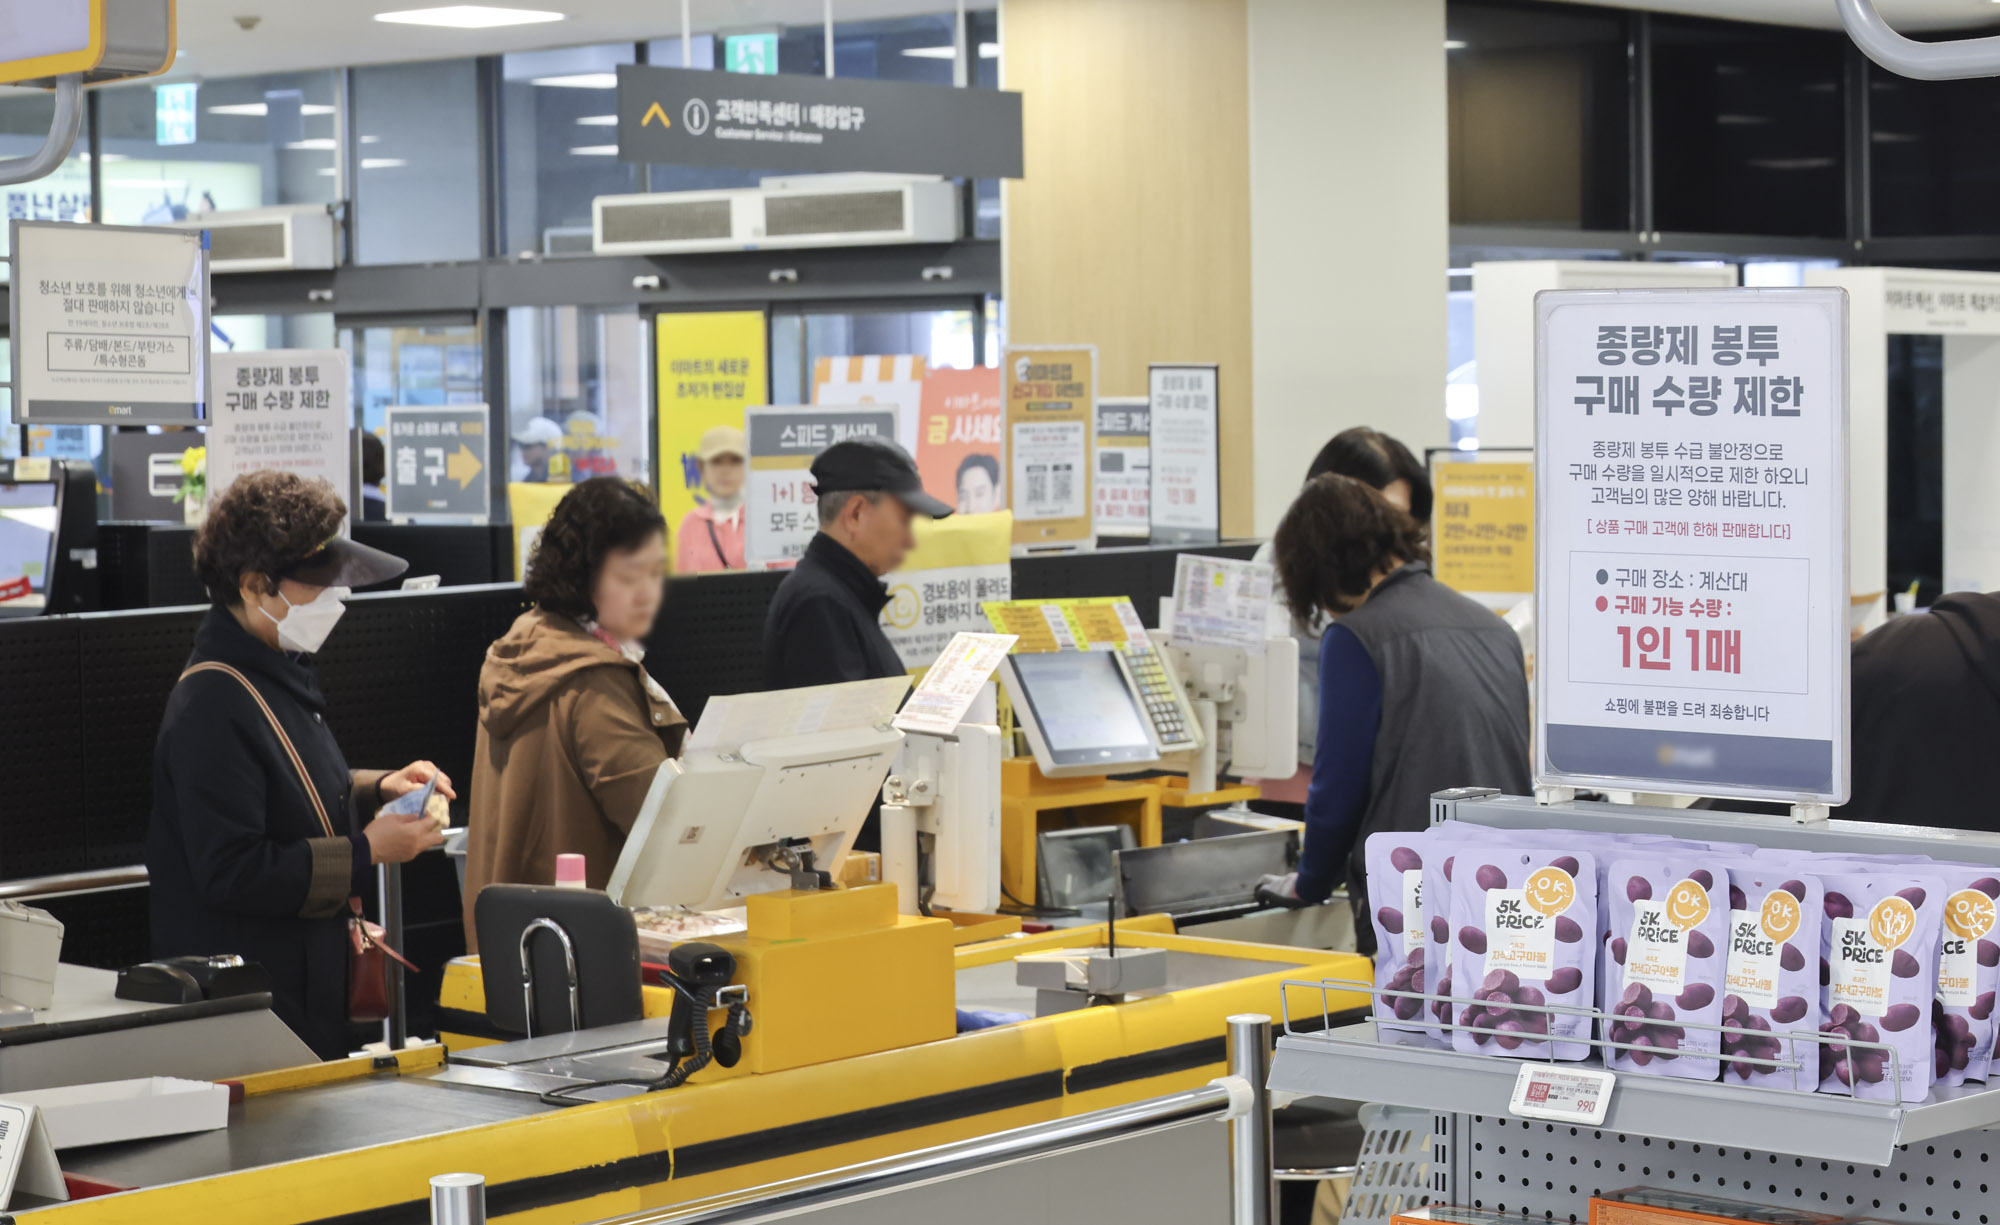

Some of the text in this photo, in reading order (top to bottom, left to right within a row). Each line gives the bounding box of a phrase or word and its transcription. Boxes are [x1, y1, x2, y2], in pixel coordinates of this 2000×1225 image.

[40, 280, 71, 295] 청소년
[75, 282, 106, 296] 보호를
[110, 283, 130, 297] 위해
[63, 298, 174, 315] 절대 판매하지 않습니다
[1596, 326, 1779, 366] 종량제 봉투
[236, 366, 319, 387] 종량제 봉투
[226, 389, 330, 412] 구매 수량 제한
[1574, 376, 1804, 417] 구매 수량 제한
[109, 406, 132, 415] emart
[781, 424, 826, 448] 스피드
[1593, 441, 1782, 461] 종량제 봉투 수급 불안정으로
[1569, 464, 1808, 486] 구매 수량을 일시적으로 제한 하오니
[772, 482, 794, 504] 1+1
[1592, 487, 1786, 508] 고객님의 많은 양해 바랍니다.
[771, 512, 797, 532] 모두
[1596, 520, 1619, 535] 상품
[1624, 521, 1648, 536] 구매
[1652, 521, 1689, 537] 고객에
[1694, 522, 1717, 537] 한해
[1722, 523, 1790, 540] 판매합니다]
[923, 579, 971, 602] 경보음이
[1615, 569, 1646, 588] 구매
[1652, 570, 1684, 590] 장소
[1699, 571, 1748, 592] 계산대
[924, 602, 971, 625] 당황하지
[1615, 596, 1646, 615] 구매
[1652, 597, 1683, 616] 가능
[1690, 598, 1722, 618] 수량
[1617, 626, 1741, 674] 1인 1매
[1604, 698, 1769, 722] 쇼핑에 불편을 드려 죄송합니다
[1537, 877, 1566, 892] OK
[1496, 900, 1520, 913] 5K
[1677, 890, 1701, 907] OK
[1956, 900, 1985, 915] OK
[1640, 911, 1660, 925] 5K
[1772, 901, 1792, 918] OK
[1735, 923, 1757, 937] 5K
[1842, 930, 1865, 945] 5K
[1727, 975, 1772, 990] 자색고구마볼
[1835, 984, 1883, 998] 자색고구마볼
[1577, 1100, 1596, 1112] 990
